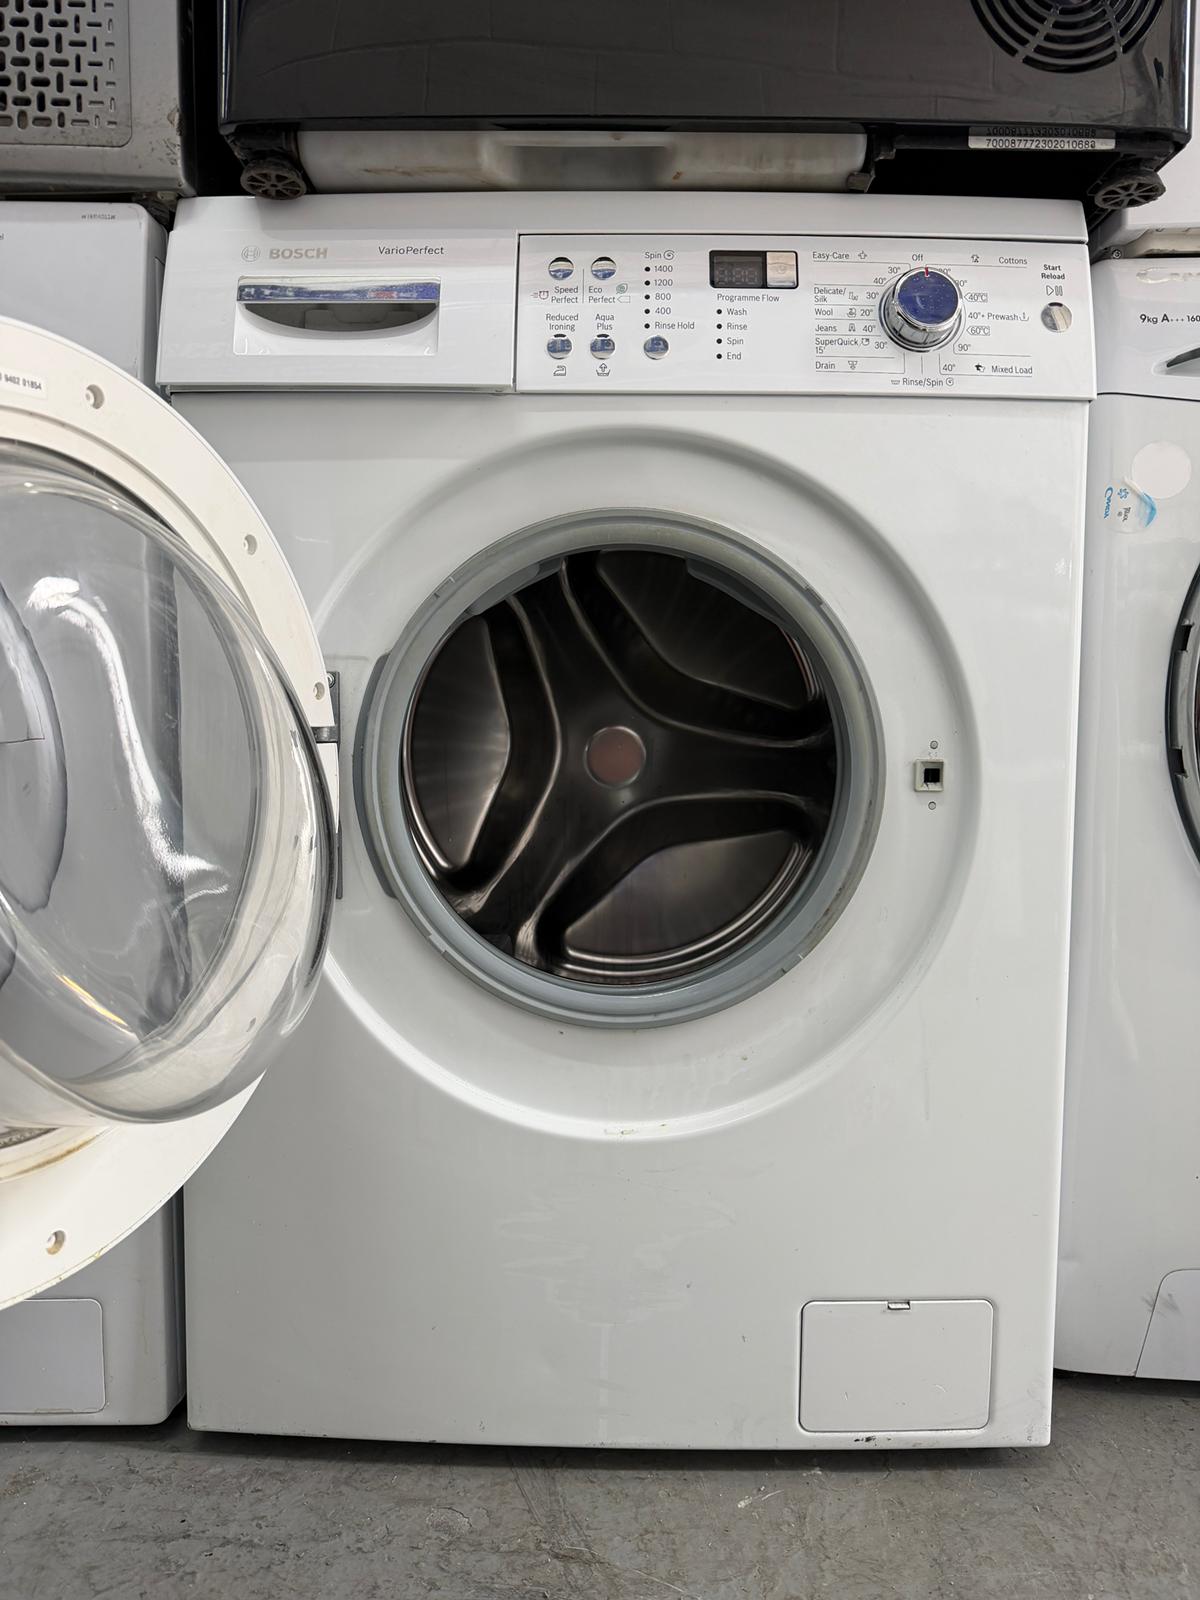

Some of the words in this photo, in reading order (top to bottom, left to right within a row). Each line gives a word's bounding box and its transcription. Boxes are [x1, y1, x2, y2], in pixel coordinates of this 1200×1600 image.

[268, 247, 328, 260] BOSCH
[378, 245, 445, 255] VarioPerfect
[644, 251, 662, 260] Spin
[812, 251, 850, 260] Easy-Care
[911, 253, 924, 262] Off
[998, 256, 1028, 265] Cottons
[653, 265, 673, 273] 1400
[887, 266, 901, 274] 30°
[1041, 272, 1065, 280] Reload
[653, 279, 673, 287] 1200
[873, 277, 887, 285] 40°
[554, 286, 578, 295] Speed
[588, 286, 603, 294] Eco
[813, 287, 846, 296] Delicate/
[551, 296, 578, 304] Perfect
[588, 296, 616, 304] Perfect
[654, 293, 672, 301] 800
[716, 293, 760, 303] Programme
[761, 294, 780, 302] Flow
[814, 295, 828, 304] Silk
[866, 291, 879, 300] 30°
[654, 307, 672, 315] 400
[726, 308, 748, 316] Wash
[814, 308, 833, 316] Wool
[860, 308, 873, 317] 20°
[545, 313, 579, 321] Reduced
[595, 313, 615, 323] Aqua
[987, 312, 1019, 321] Prewash
[1139, 313, 1158, 325] 9kg
[549, 322, 576, 332] Ironing
[596, 323, 613, 331] Plus
[654, 321, 676, 330] Rinse
[677, 321, 695, 330] Hold
[726, 322, 748, 331] Rinse
[815, 324, 837, 332] Jeans
[862, 324, 876, 333] 40°
[726, 337, 744, 346] Spin
[814, 337, 859, 347] SuperQuick
[874, 341, 888, 350] 30°
[726, 351, 742, 360] End
[815, 361, 836, 370] Drain
[942, 363, 956, 372] 40°
[991, 365, 1014, 374] Mixed
[1015, 366, 1033, 374] Load
[902, 377, 944, 387] Rinse/Spin
